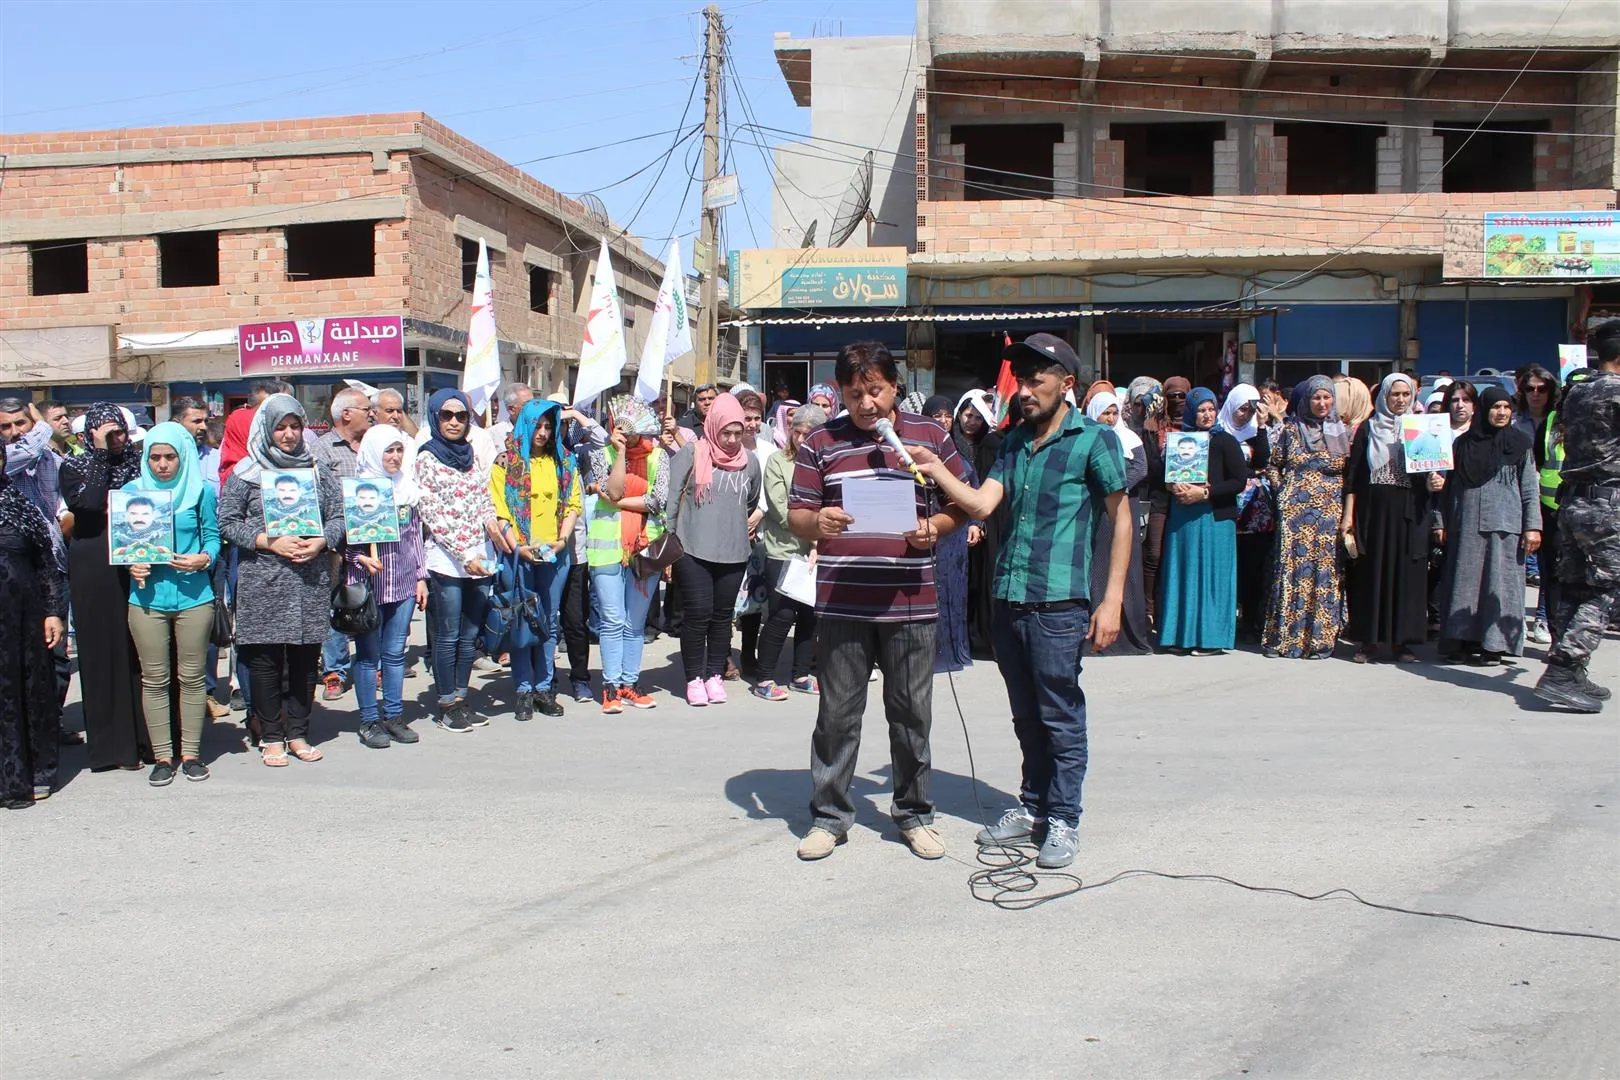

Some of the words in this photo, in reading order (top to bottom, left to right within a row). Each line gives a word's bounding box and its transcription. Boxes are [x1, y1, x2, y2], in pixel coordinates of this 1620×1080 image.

[866, 269, 897, 281] مكتبة
[244, 326, 294, 352] هيلين
[330, 320, 398, 345] صيدلية
[271, 351, 359, 366] DERMANXANE
